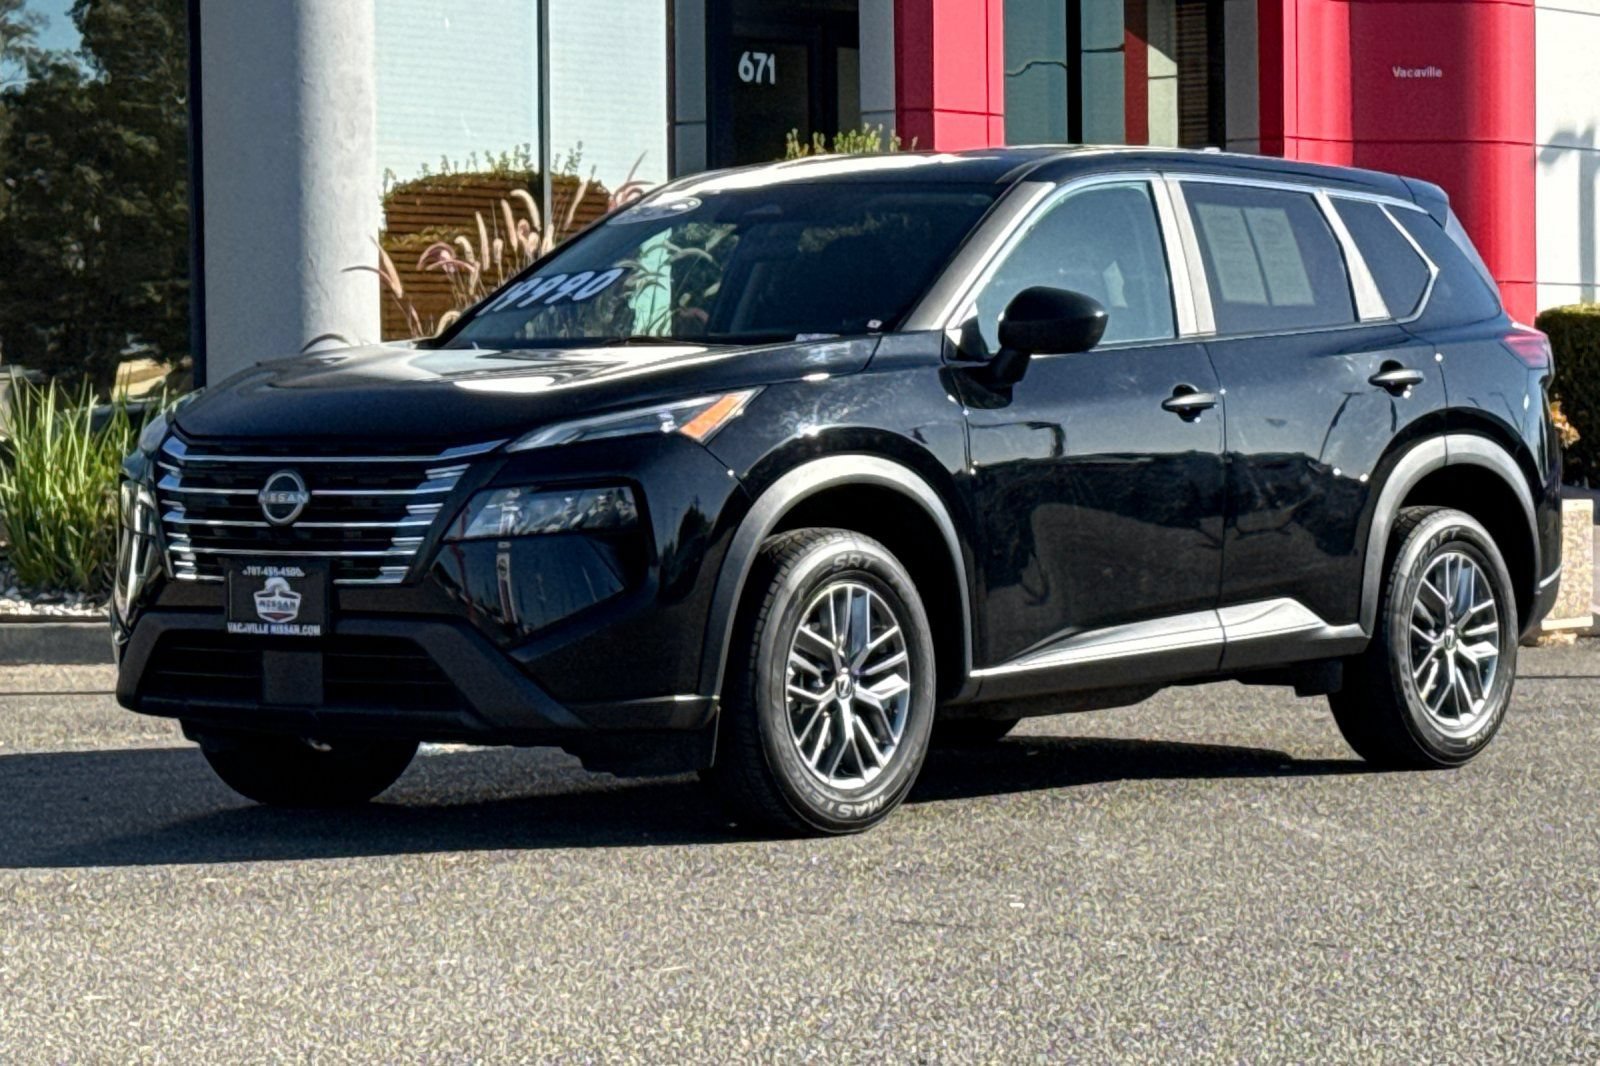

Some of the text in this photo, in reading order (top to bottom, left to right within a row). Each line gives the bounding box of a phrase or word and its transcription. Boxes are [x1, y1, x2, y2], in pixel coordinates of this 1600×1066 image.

[738, 51, 775, 85] 671
[1392, 65, 1443, 78] Vacaville
[260, 600, 297, 608] NISSAN
